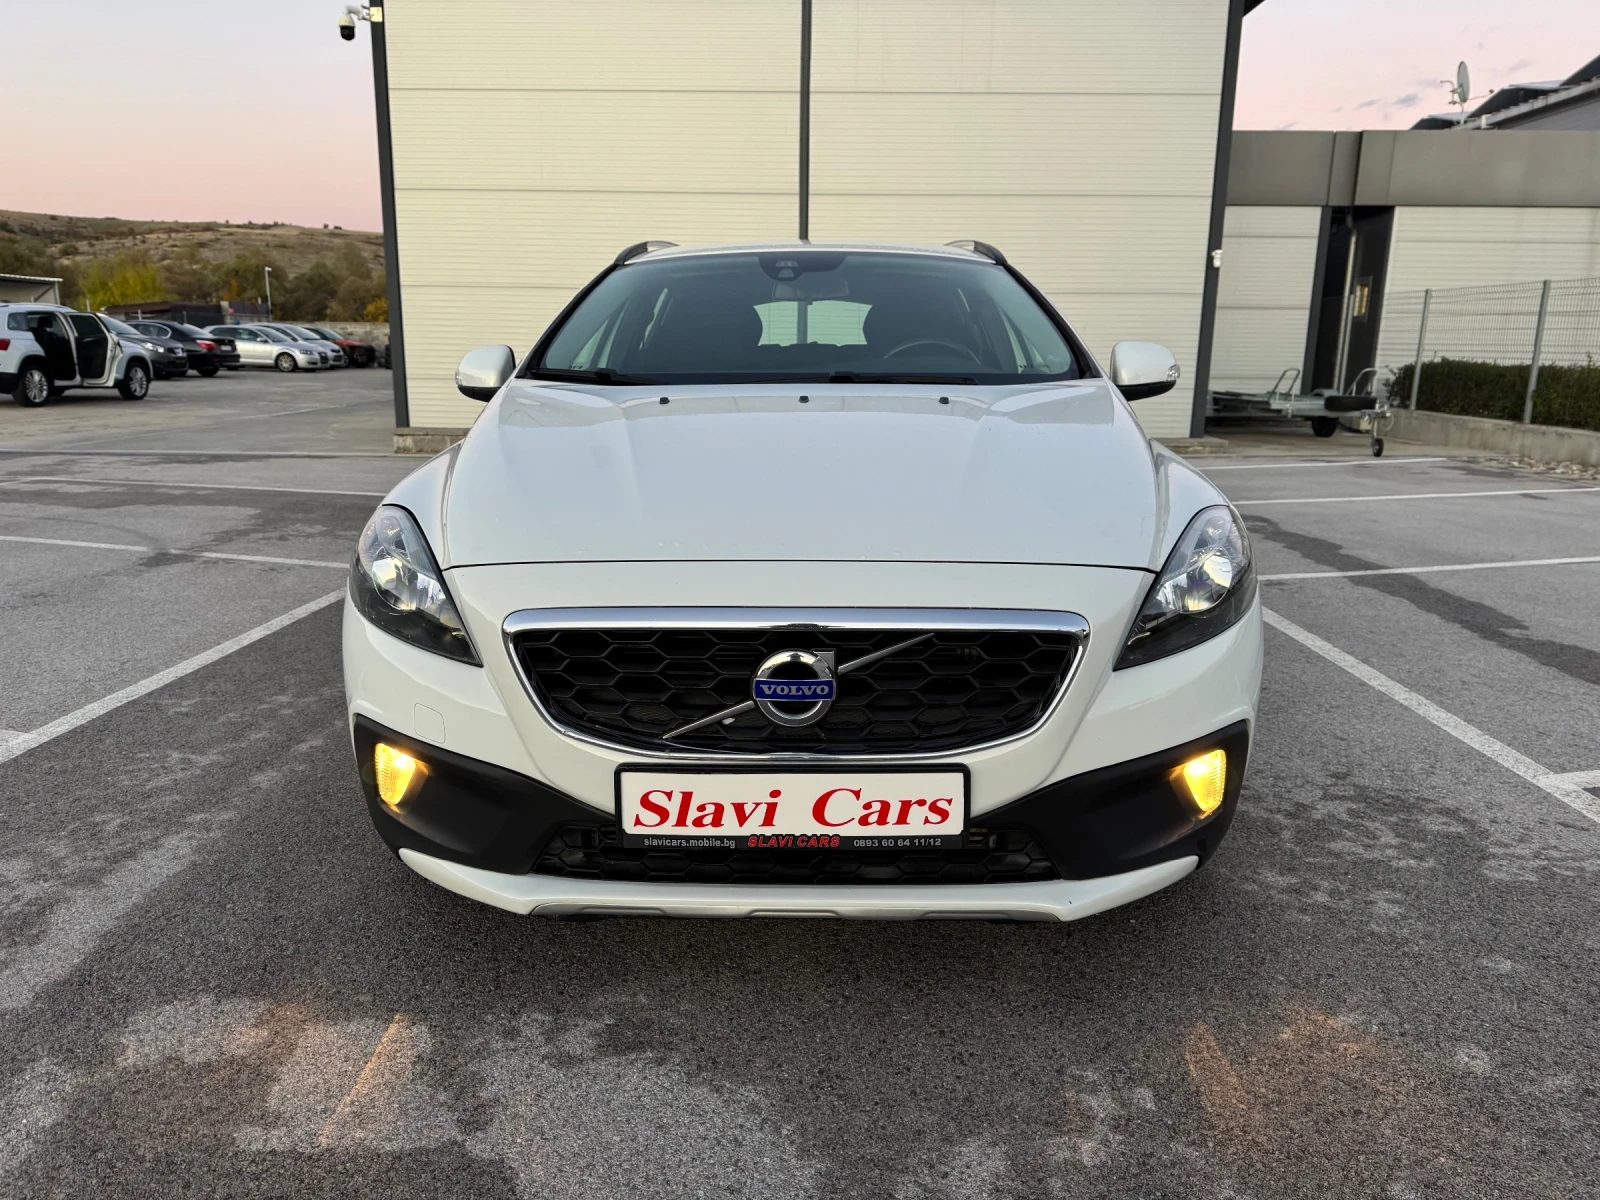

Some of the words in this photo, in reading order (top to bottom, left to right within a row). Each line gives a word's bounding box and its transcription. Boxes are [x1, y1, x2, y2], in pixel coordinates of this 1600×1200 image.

[760, 684, 829, 696] VOLVO
[633, 789, 782, 829] Slavi
[811, 787, 954, 828] Cars
[643, 836, 736, 849] slavicars.mobile.bg
[747, 835, 793, 848] SLAVI
[797, 835, 841, 848] CARS
[853, 838, 879, 847] 0893
[882, 838, 895, 847] 60
[897, 838, 911, 847] 64
[913, 837, 942, 847] 11/12
